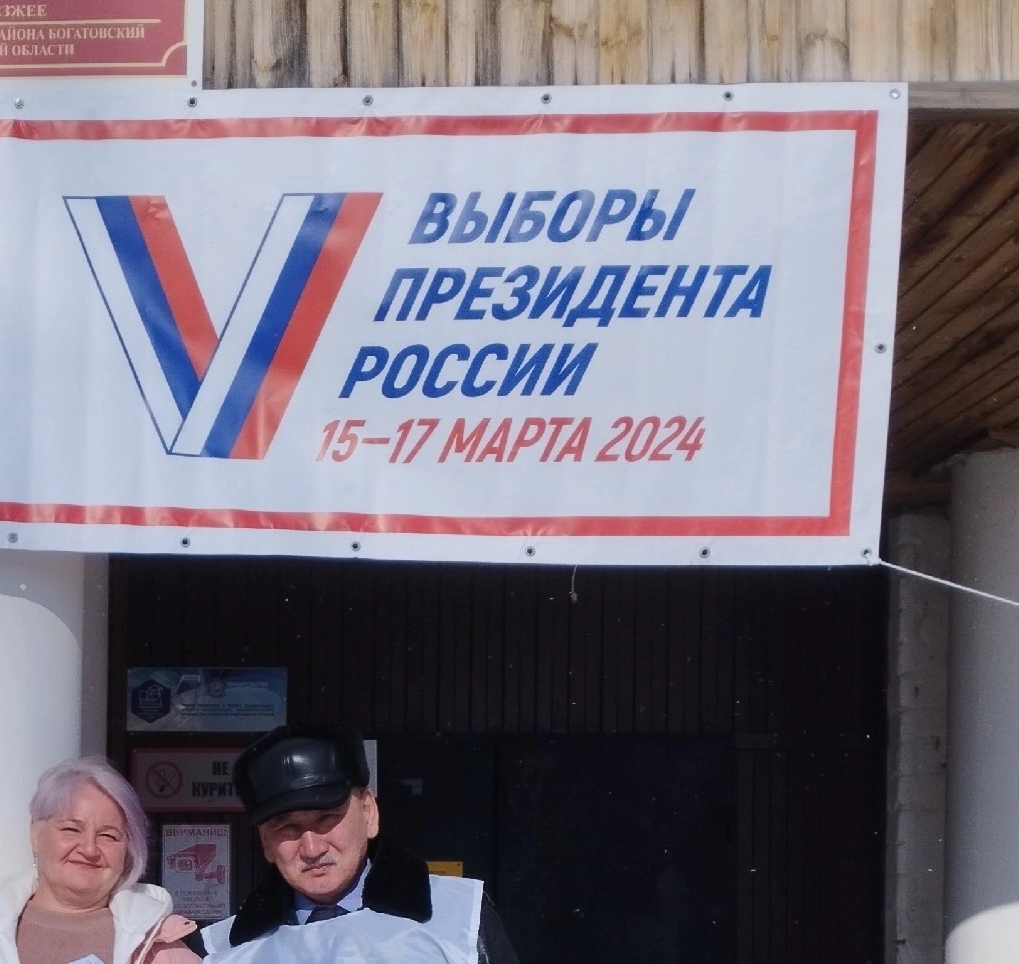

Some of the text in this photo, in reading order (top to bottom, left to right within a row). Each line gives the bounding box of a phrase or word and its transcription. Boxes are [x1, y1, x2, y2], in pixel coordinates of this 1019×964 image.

[48, 23, 145, 40] БОГАТОВСКИЙ
[11, 43, 75, 56] ОБЛАСТИ
[409, 188, 696, 246] ВЫБОРЫ
[373, 264, 773, 328] ПРЕЗИДЕНТА
[339, 343, 599, 400] РОССИИ
[440, 417, 590, 464] МАРТА
[594, 416, 707, 463] 2024
[212, 761, 229, 776] НЕ
[192, 782, 238, 797] КУРИТ
